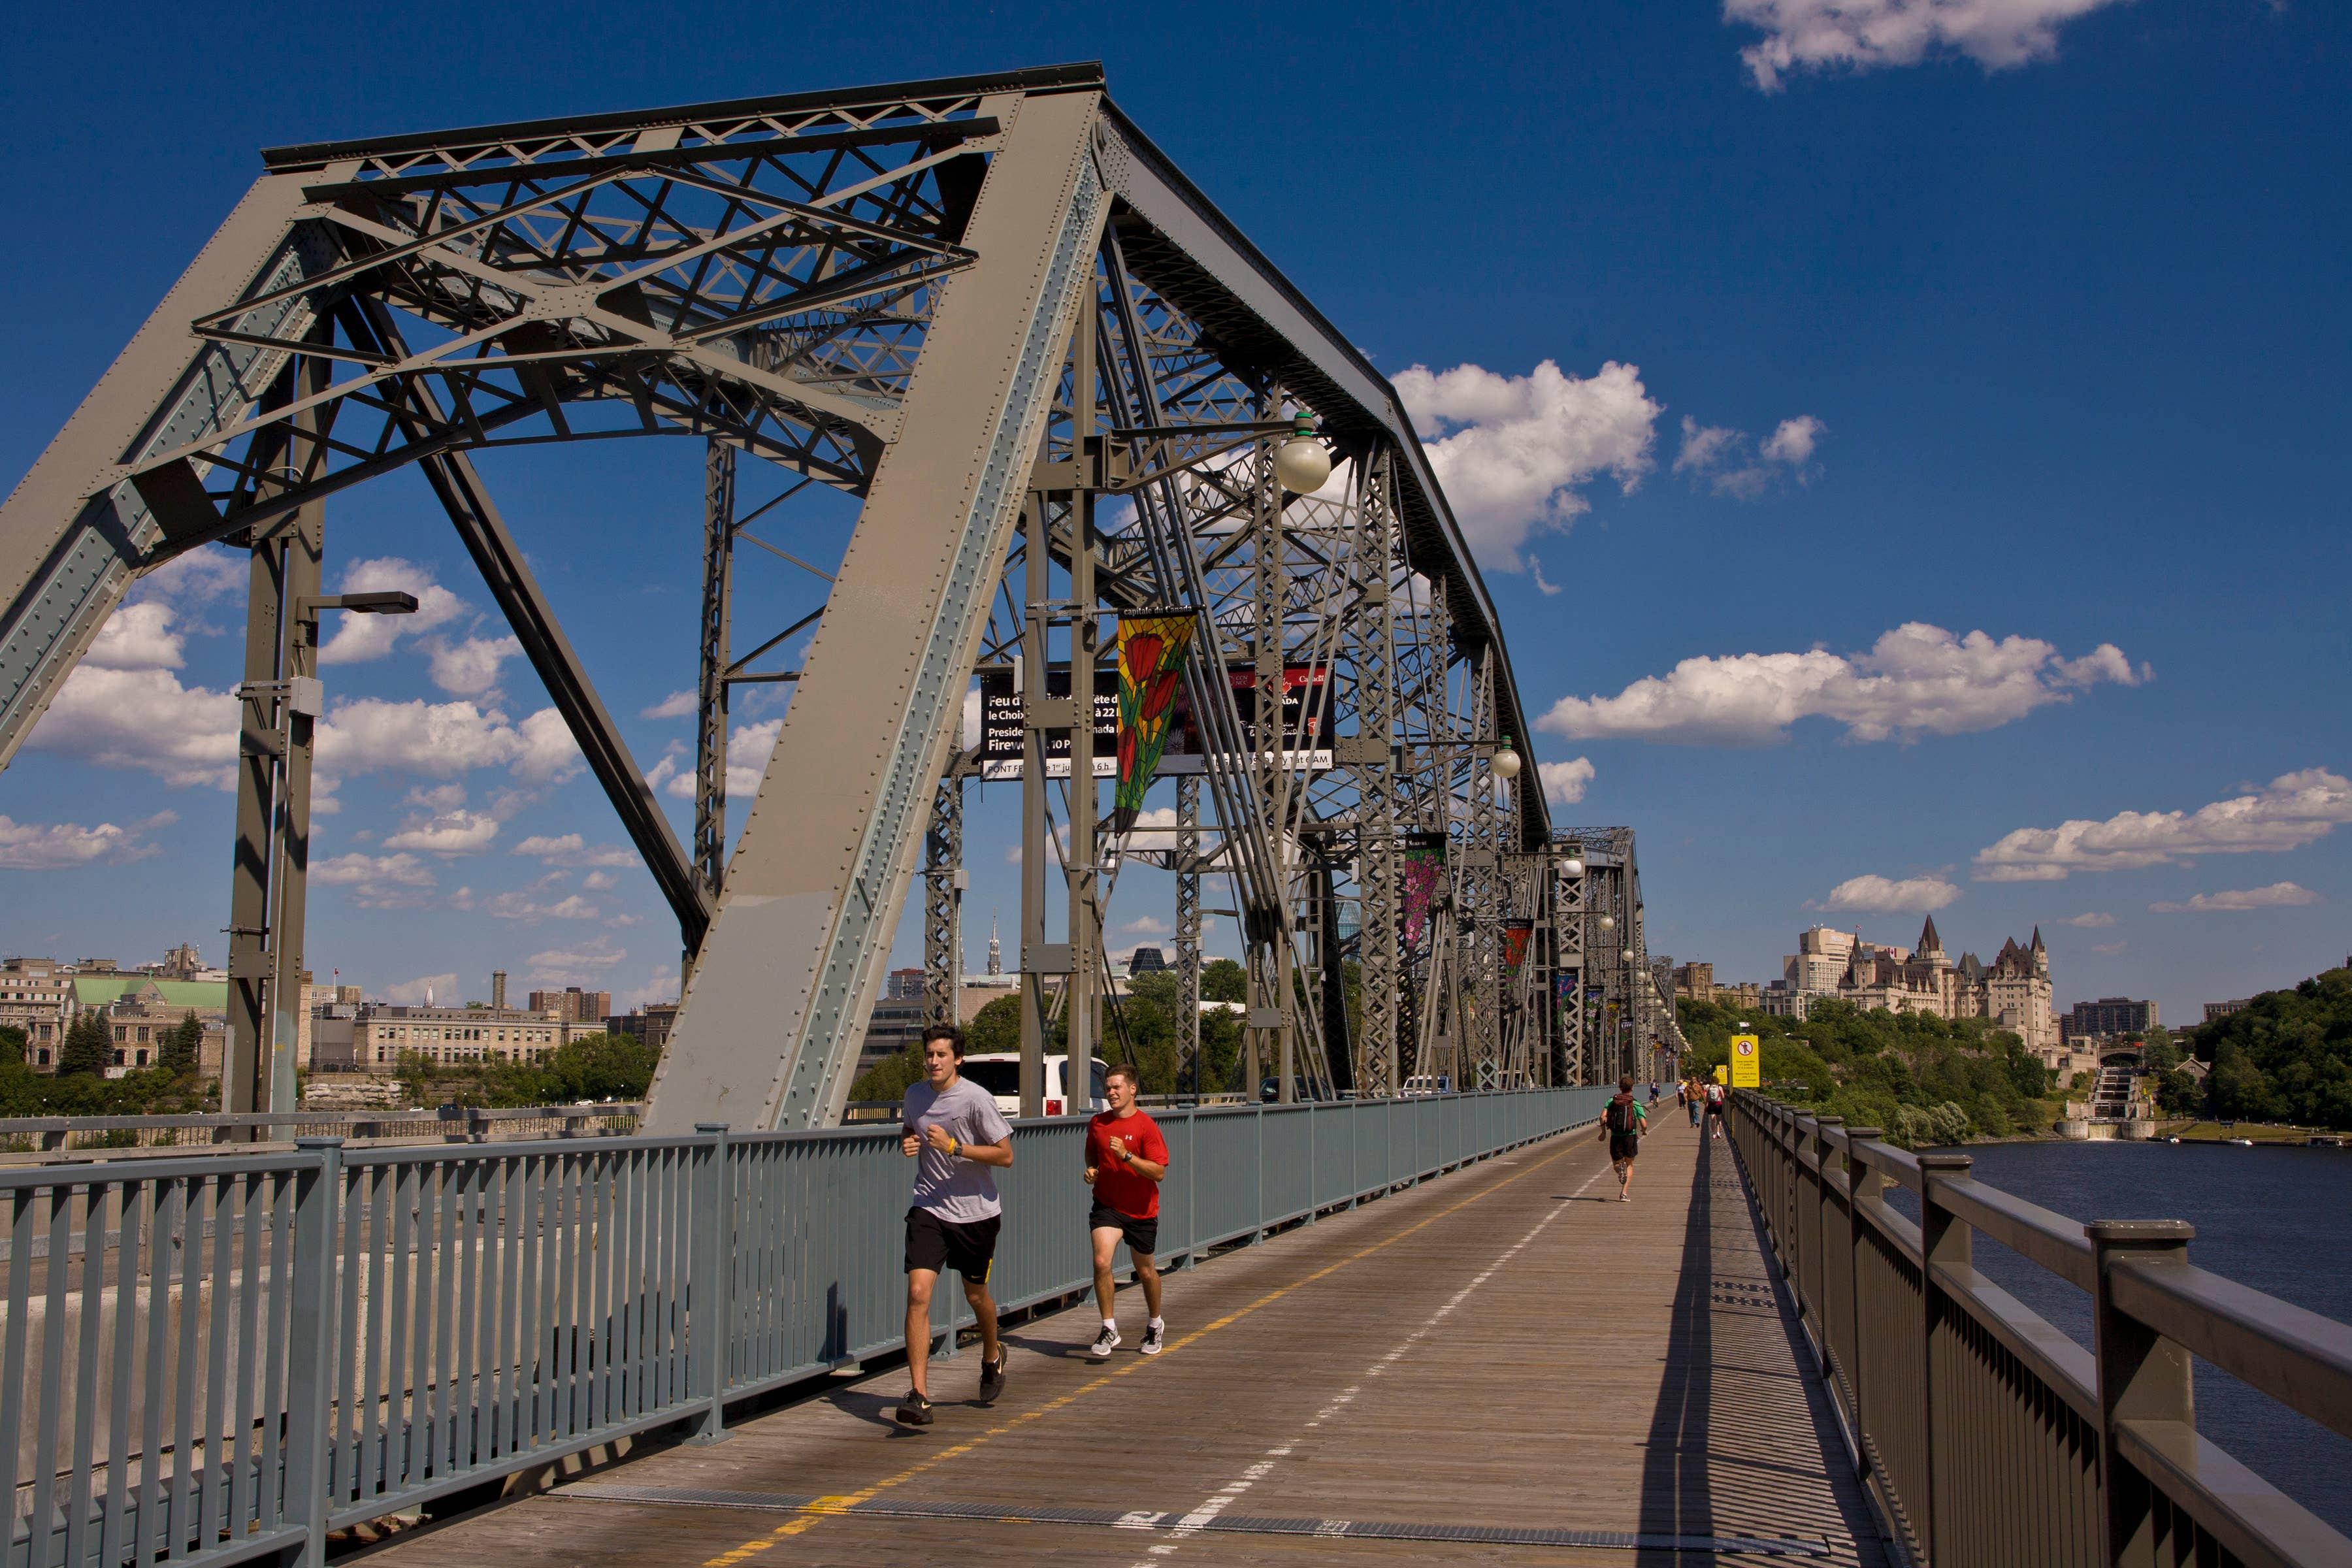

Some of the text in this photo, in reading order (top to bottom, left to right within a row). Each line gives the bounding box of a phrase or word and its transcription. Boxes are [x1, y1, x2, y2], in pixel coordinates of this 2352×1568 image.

[1124, 607, 1152, 616] capitale
[1166, 605, 1192, 613] Canada
[988, 696, 1010, 707] Feu
[1092, 694, 1110, 704] ête
[988, 711, 998, 720] le
[1095, 708, 1102, 717] à
[1102, 708, 1115, 717] 22
[988, 727, 1024, 737] Preside
[1092, 724, 1115, 734] nada
[1051, 740, 1062, 749] 10
